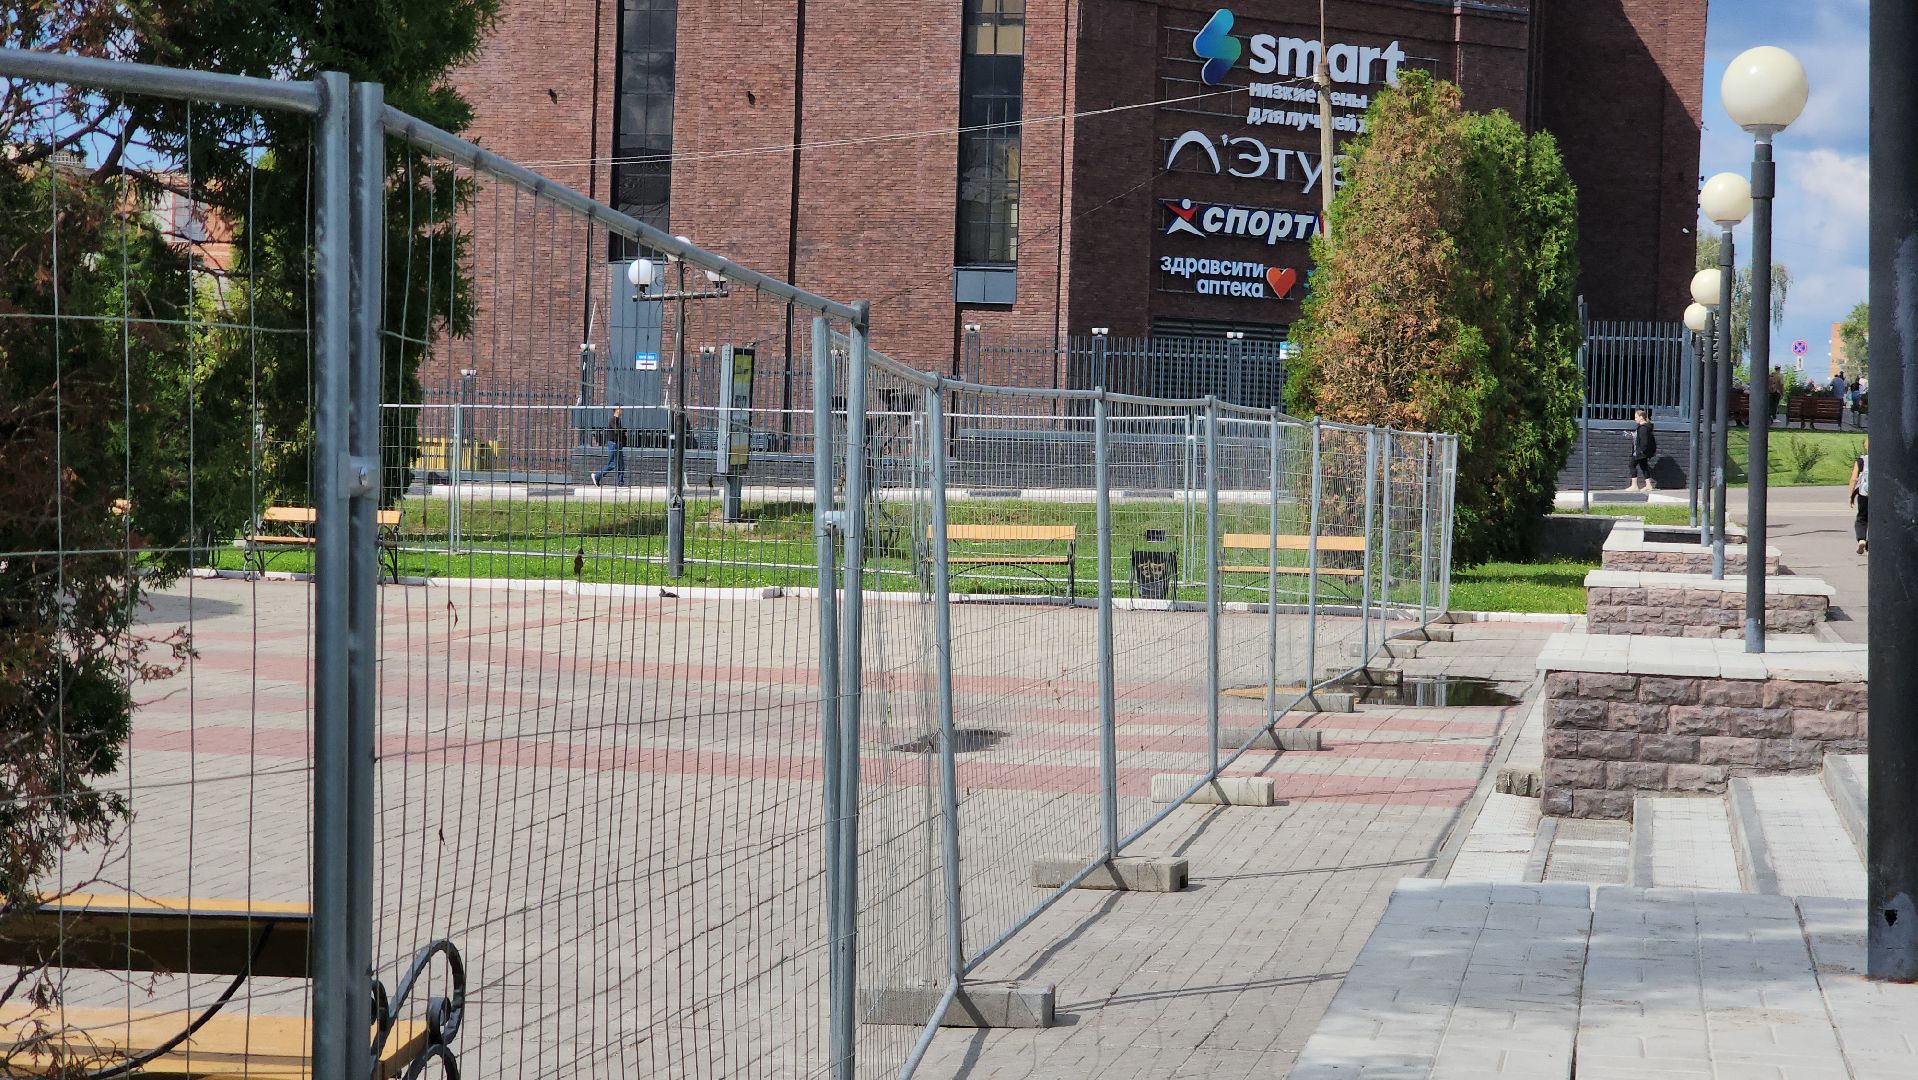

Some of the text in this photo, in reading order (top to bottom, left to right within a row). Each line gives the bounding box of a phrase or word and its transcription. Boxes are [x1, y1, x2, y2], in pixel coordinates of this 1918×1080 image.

[1249, 33, 1405, 89] smart
[1249, 82, 1368, 109] низкие ены
[1246, 107, 1285, 126] для
[1285, 111, 1357, 132] лучей
[1160, 255, 1264, 279] здравсити
[1196, 278, 1264, 298] аптека
